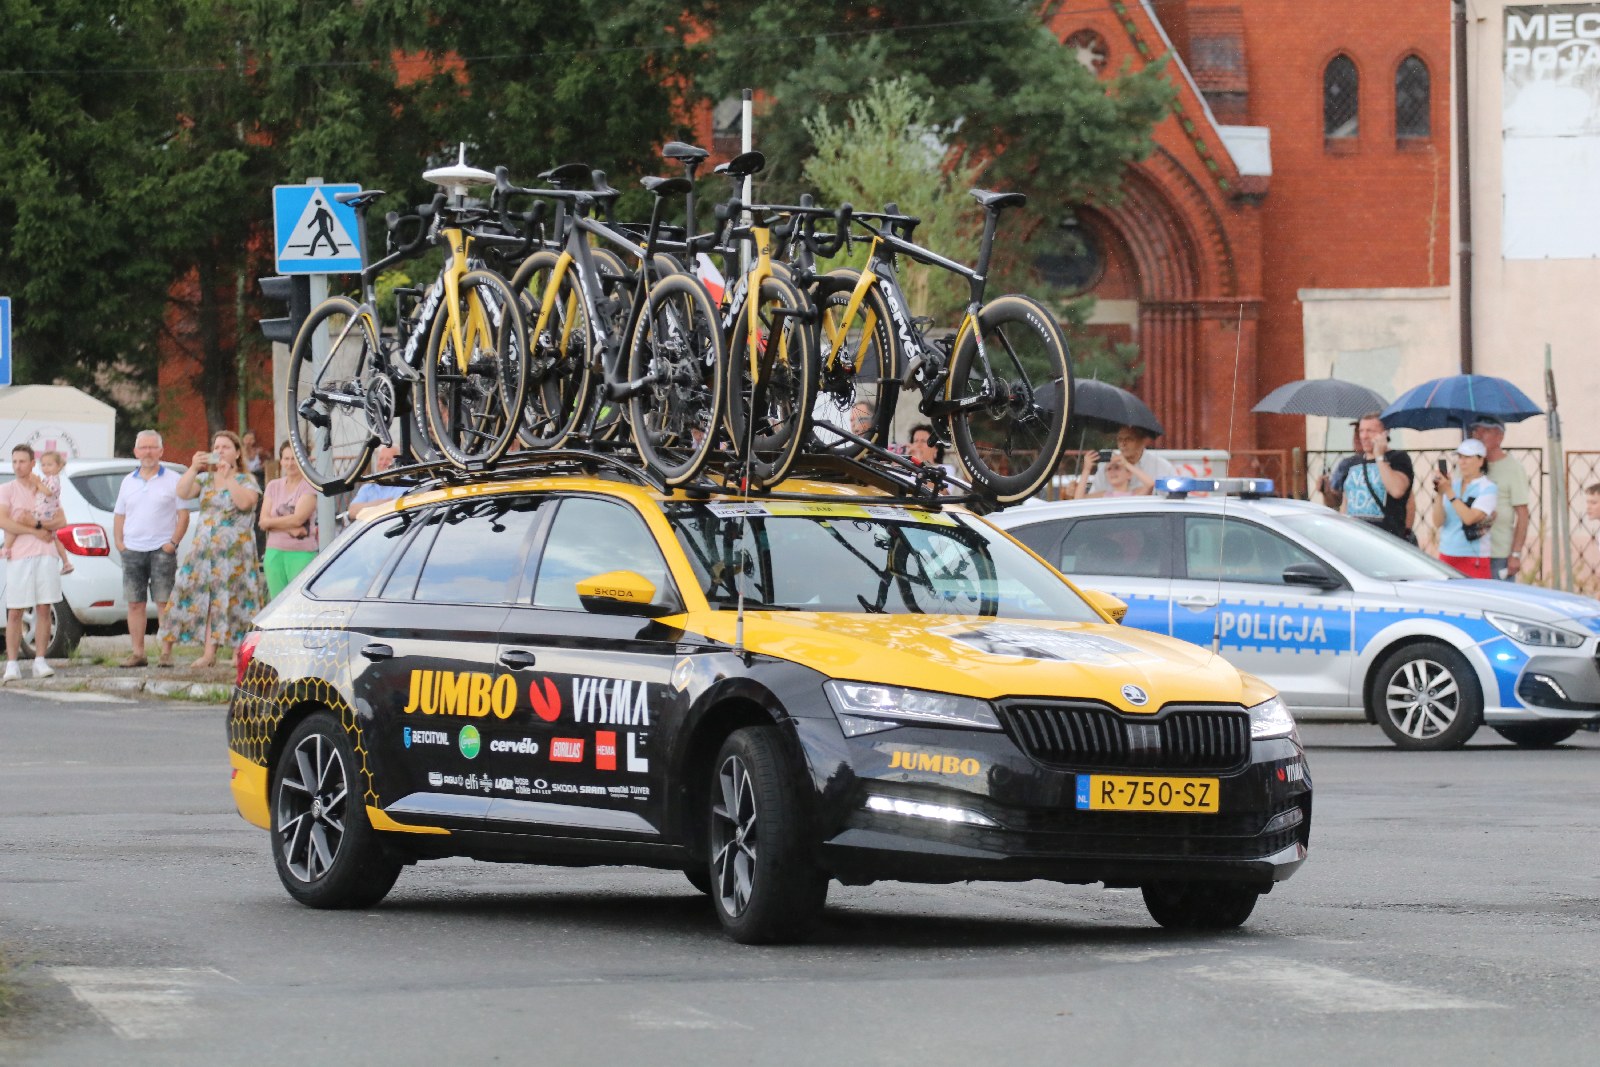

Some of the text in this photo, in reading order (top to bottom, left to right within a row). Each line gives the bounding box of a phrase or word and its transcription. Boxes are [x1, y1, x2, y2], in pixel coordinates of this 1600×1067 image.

[1507, 13, 1600, 40] MEC
[1026, 312, 1050, 343] RESERVE
[1220, 611, 1327, 644] POLICJA
[403, 669, 650, 726] JUMBO VISMA
[489, 737, 539, 755] cervélo
[553, 741, 581, 758] GORILLAS
[597, 745, 616, 756] HEMA
[887, 751, 981, 776] JUMBO
[580, 785, 607, 795] SRAM
[1077, 795, 1089, 803] NL
[1101, 780, 1211, 807] R-750-SZ
